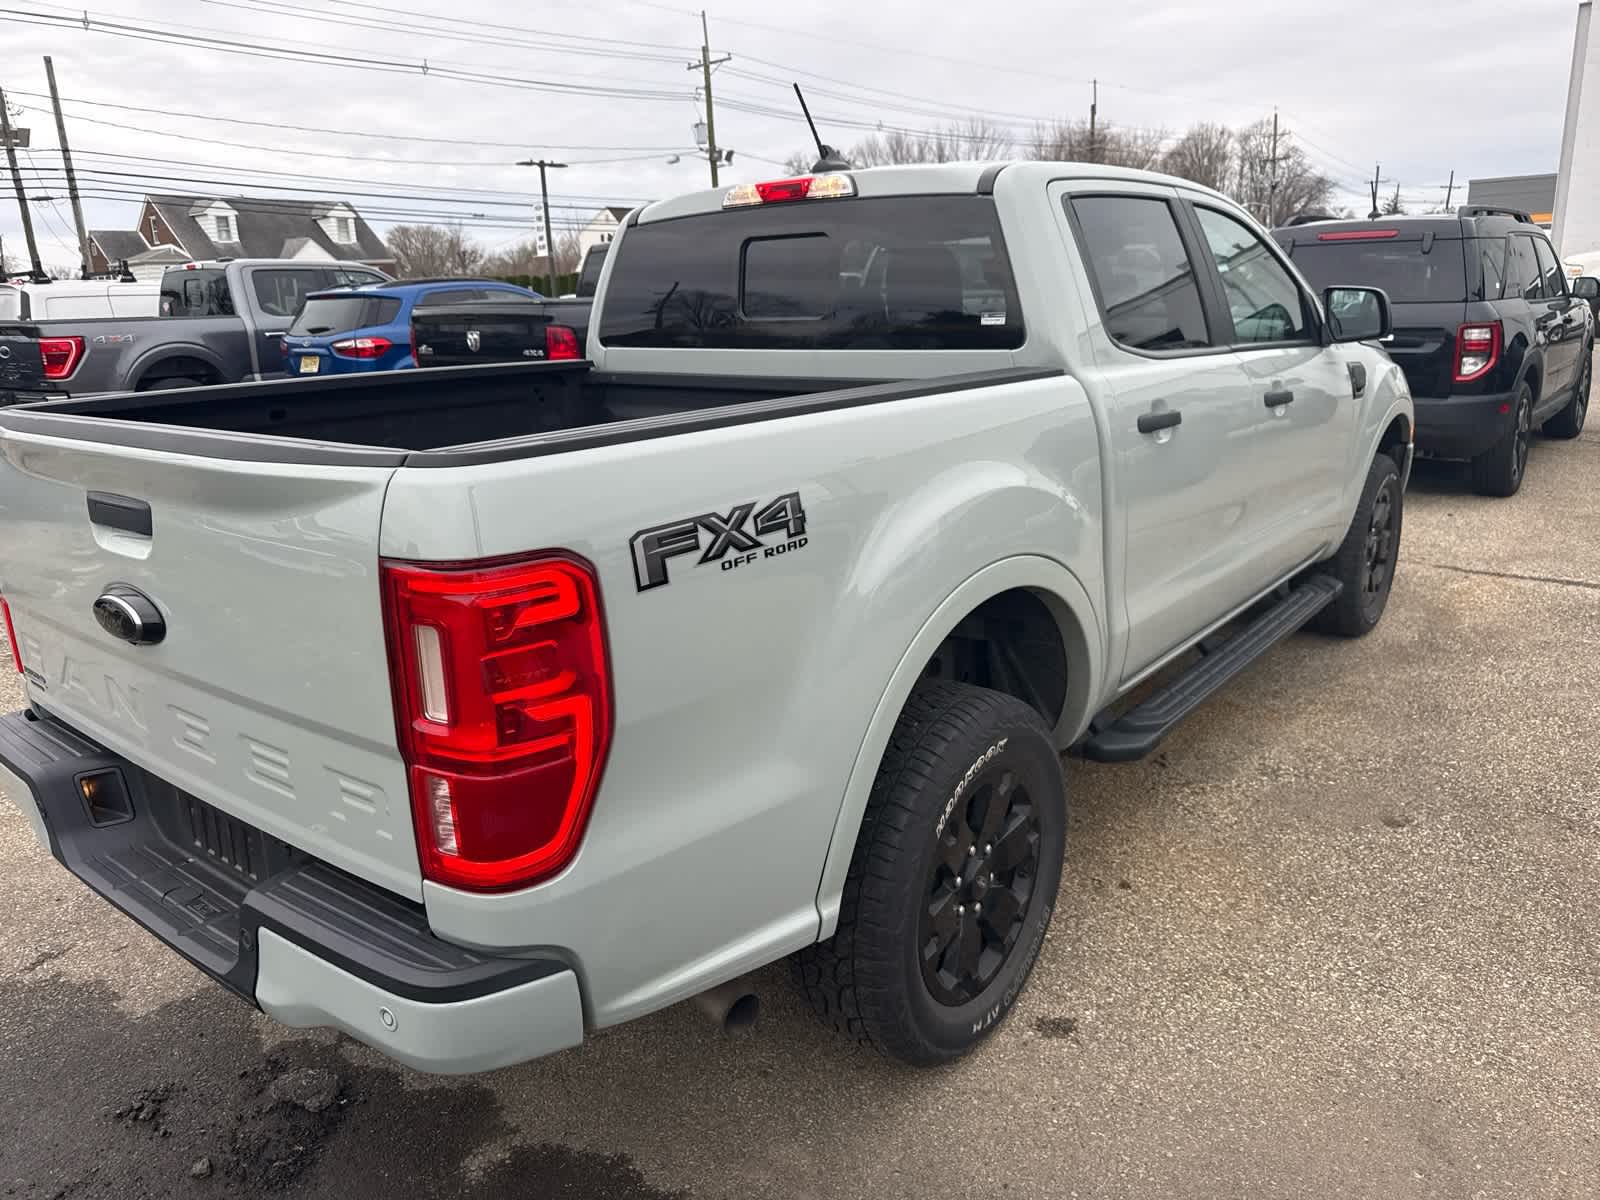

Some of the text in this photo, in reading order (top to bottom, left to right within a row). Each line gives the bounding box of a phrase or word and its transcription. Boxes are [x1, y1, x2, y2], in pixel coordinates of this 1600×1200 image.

[628, 491, 807, 592] FX4
[721, 537, 809, 571] OFF ROAD
